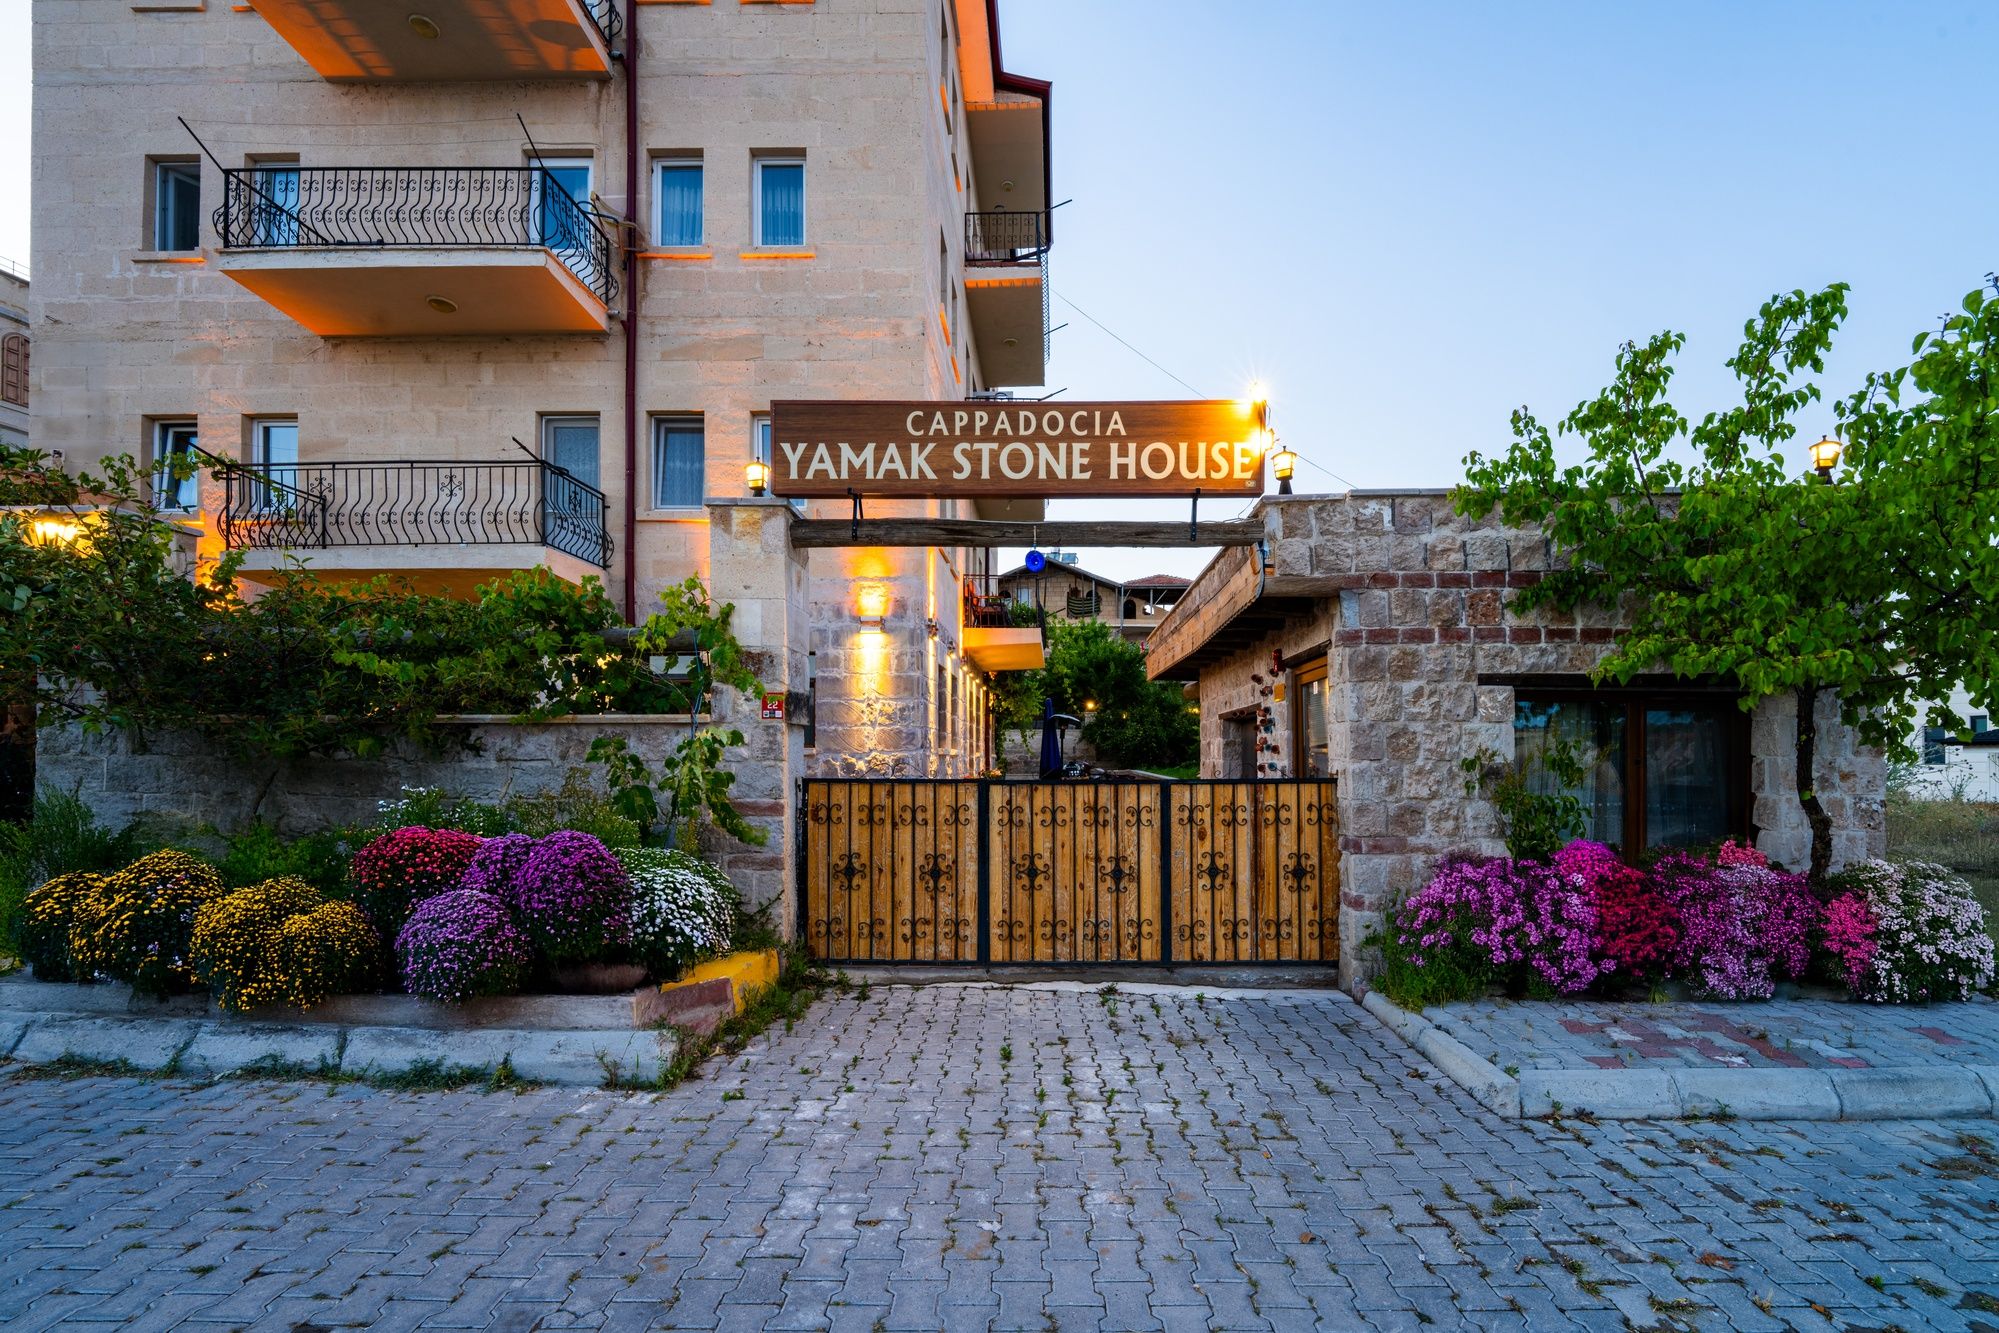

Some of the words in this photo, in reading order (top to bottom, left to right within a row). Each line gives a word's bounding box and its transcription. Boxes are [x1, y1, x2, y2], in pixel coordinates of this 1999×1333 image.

[906, 410, 1127, 436] CAPPADOCIA
[779, 442, 938, 480] YAMAK
[952, 441, 1093, 480] STONE
[1109, 441, 1254, 480] HOUSE
